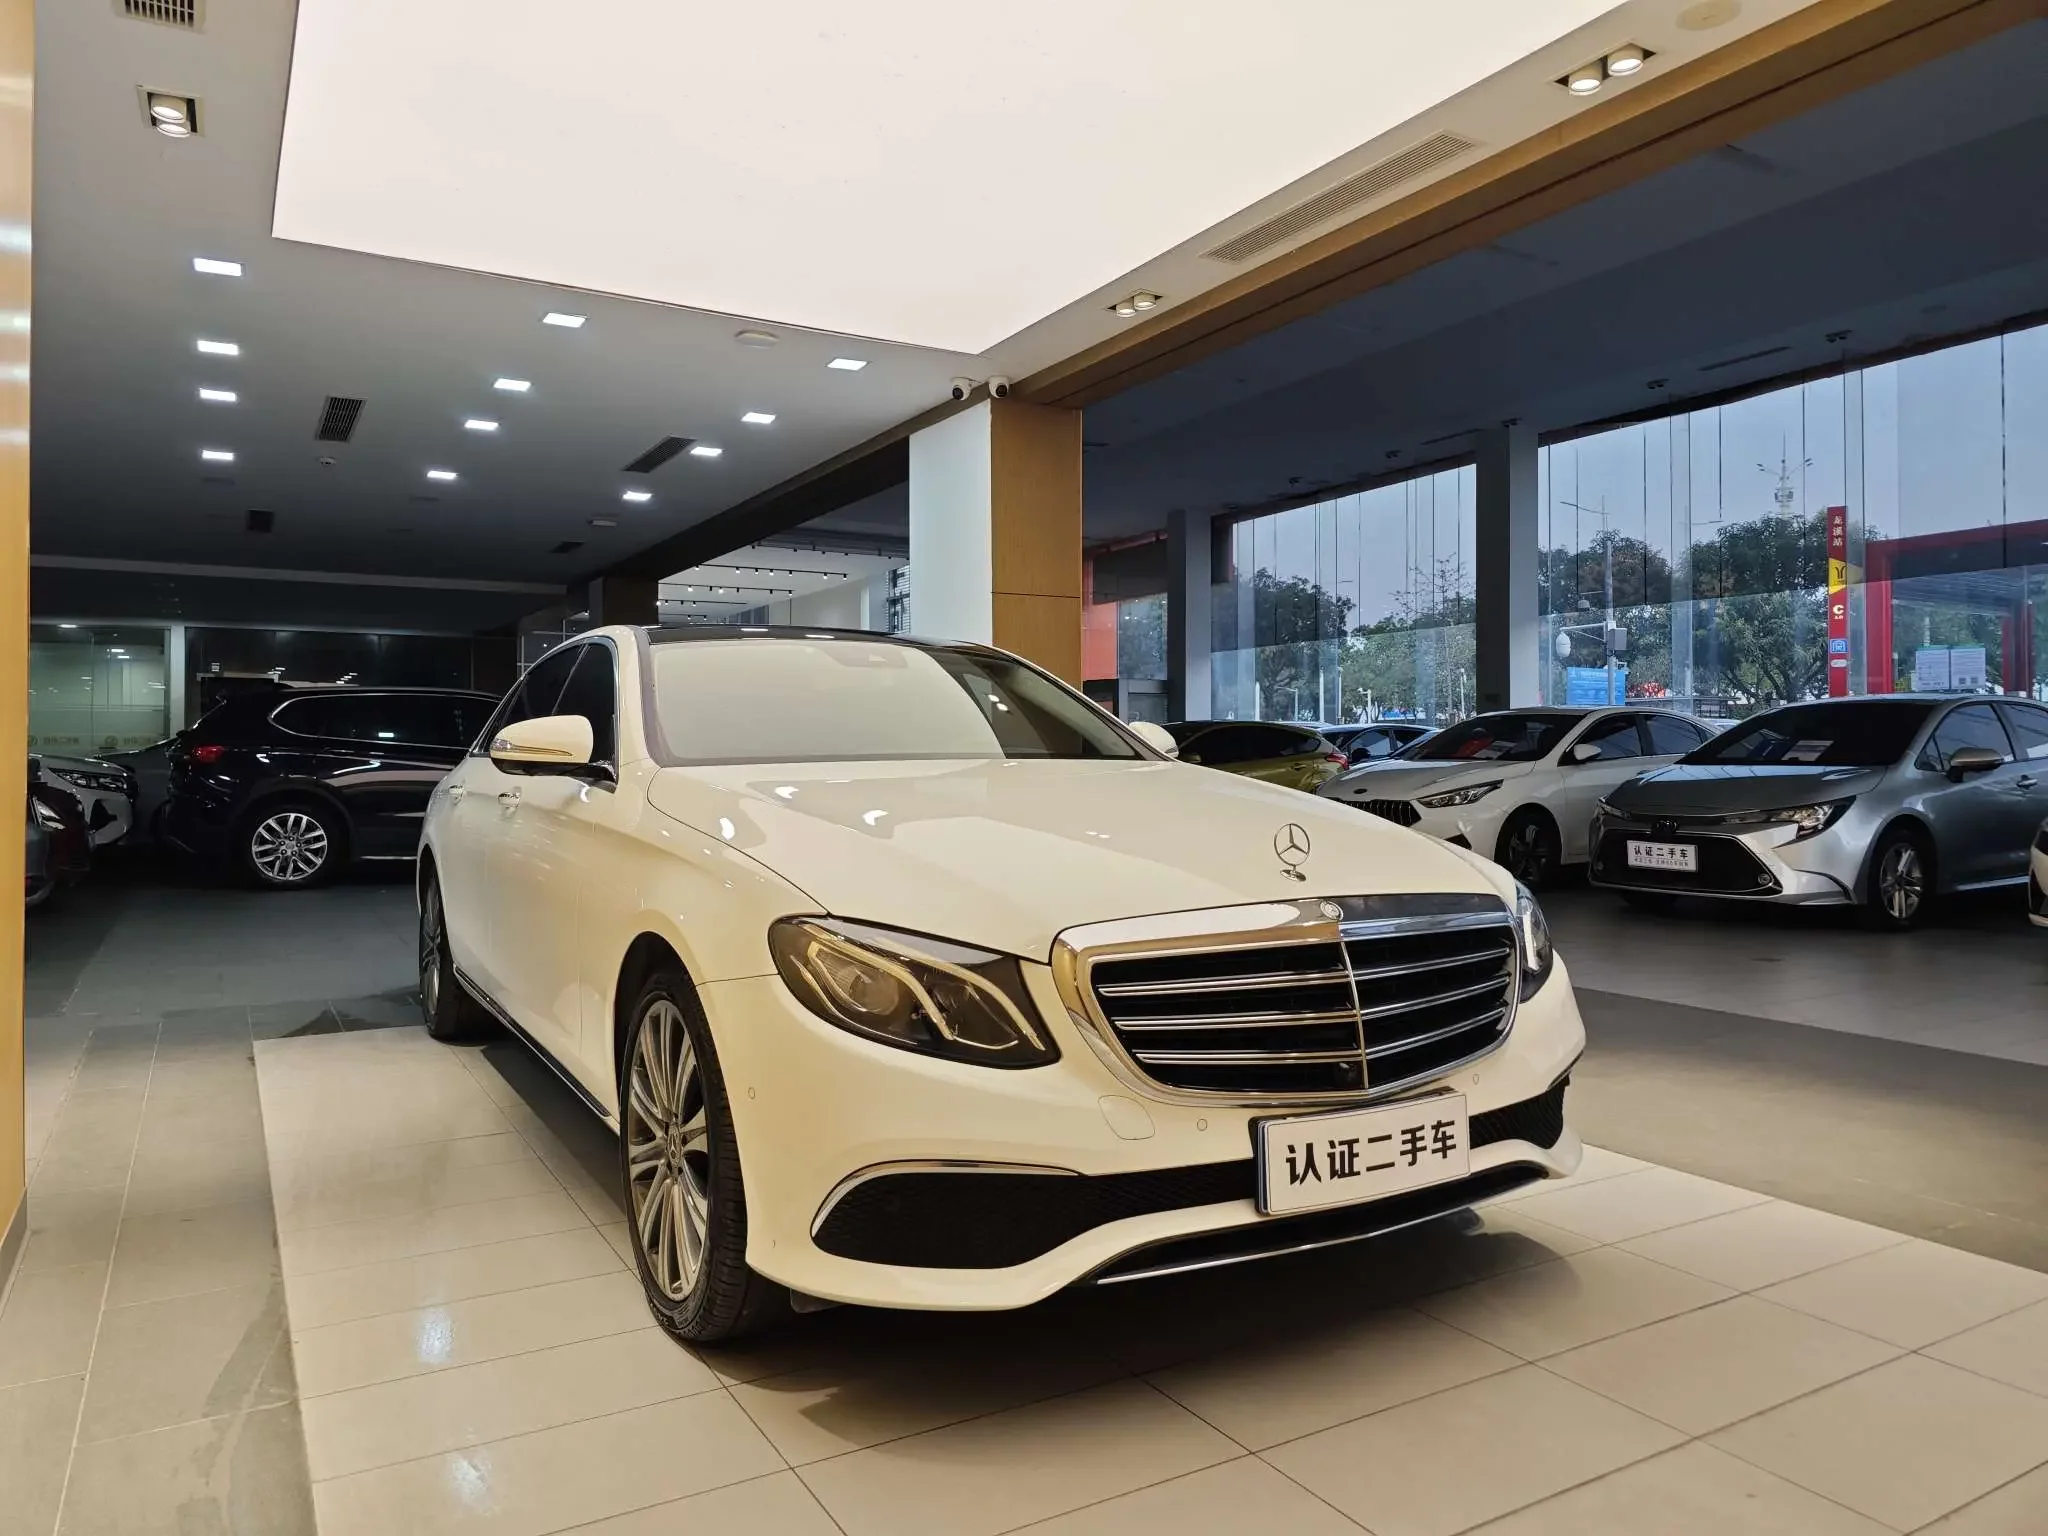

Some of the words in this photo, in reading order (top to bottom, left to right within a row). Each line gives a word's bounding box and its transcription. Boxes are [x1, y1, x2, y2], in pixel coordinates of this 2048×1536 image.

[1833, 604, 1844, 615] C
[1633, 845, 1689, 860] 认证二手车
[1285, 1119, 1457, 1186] 认证二手车
